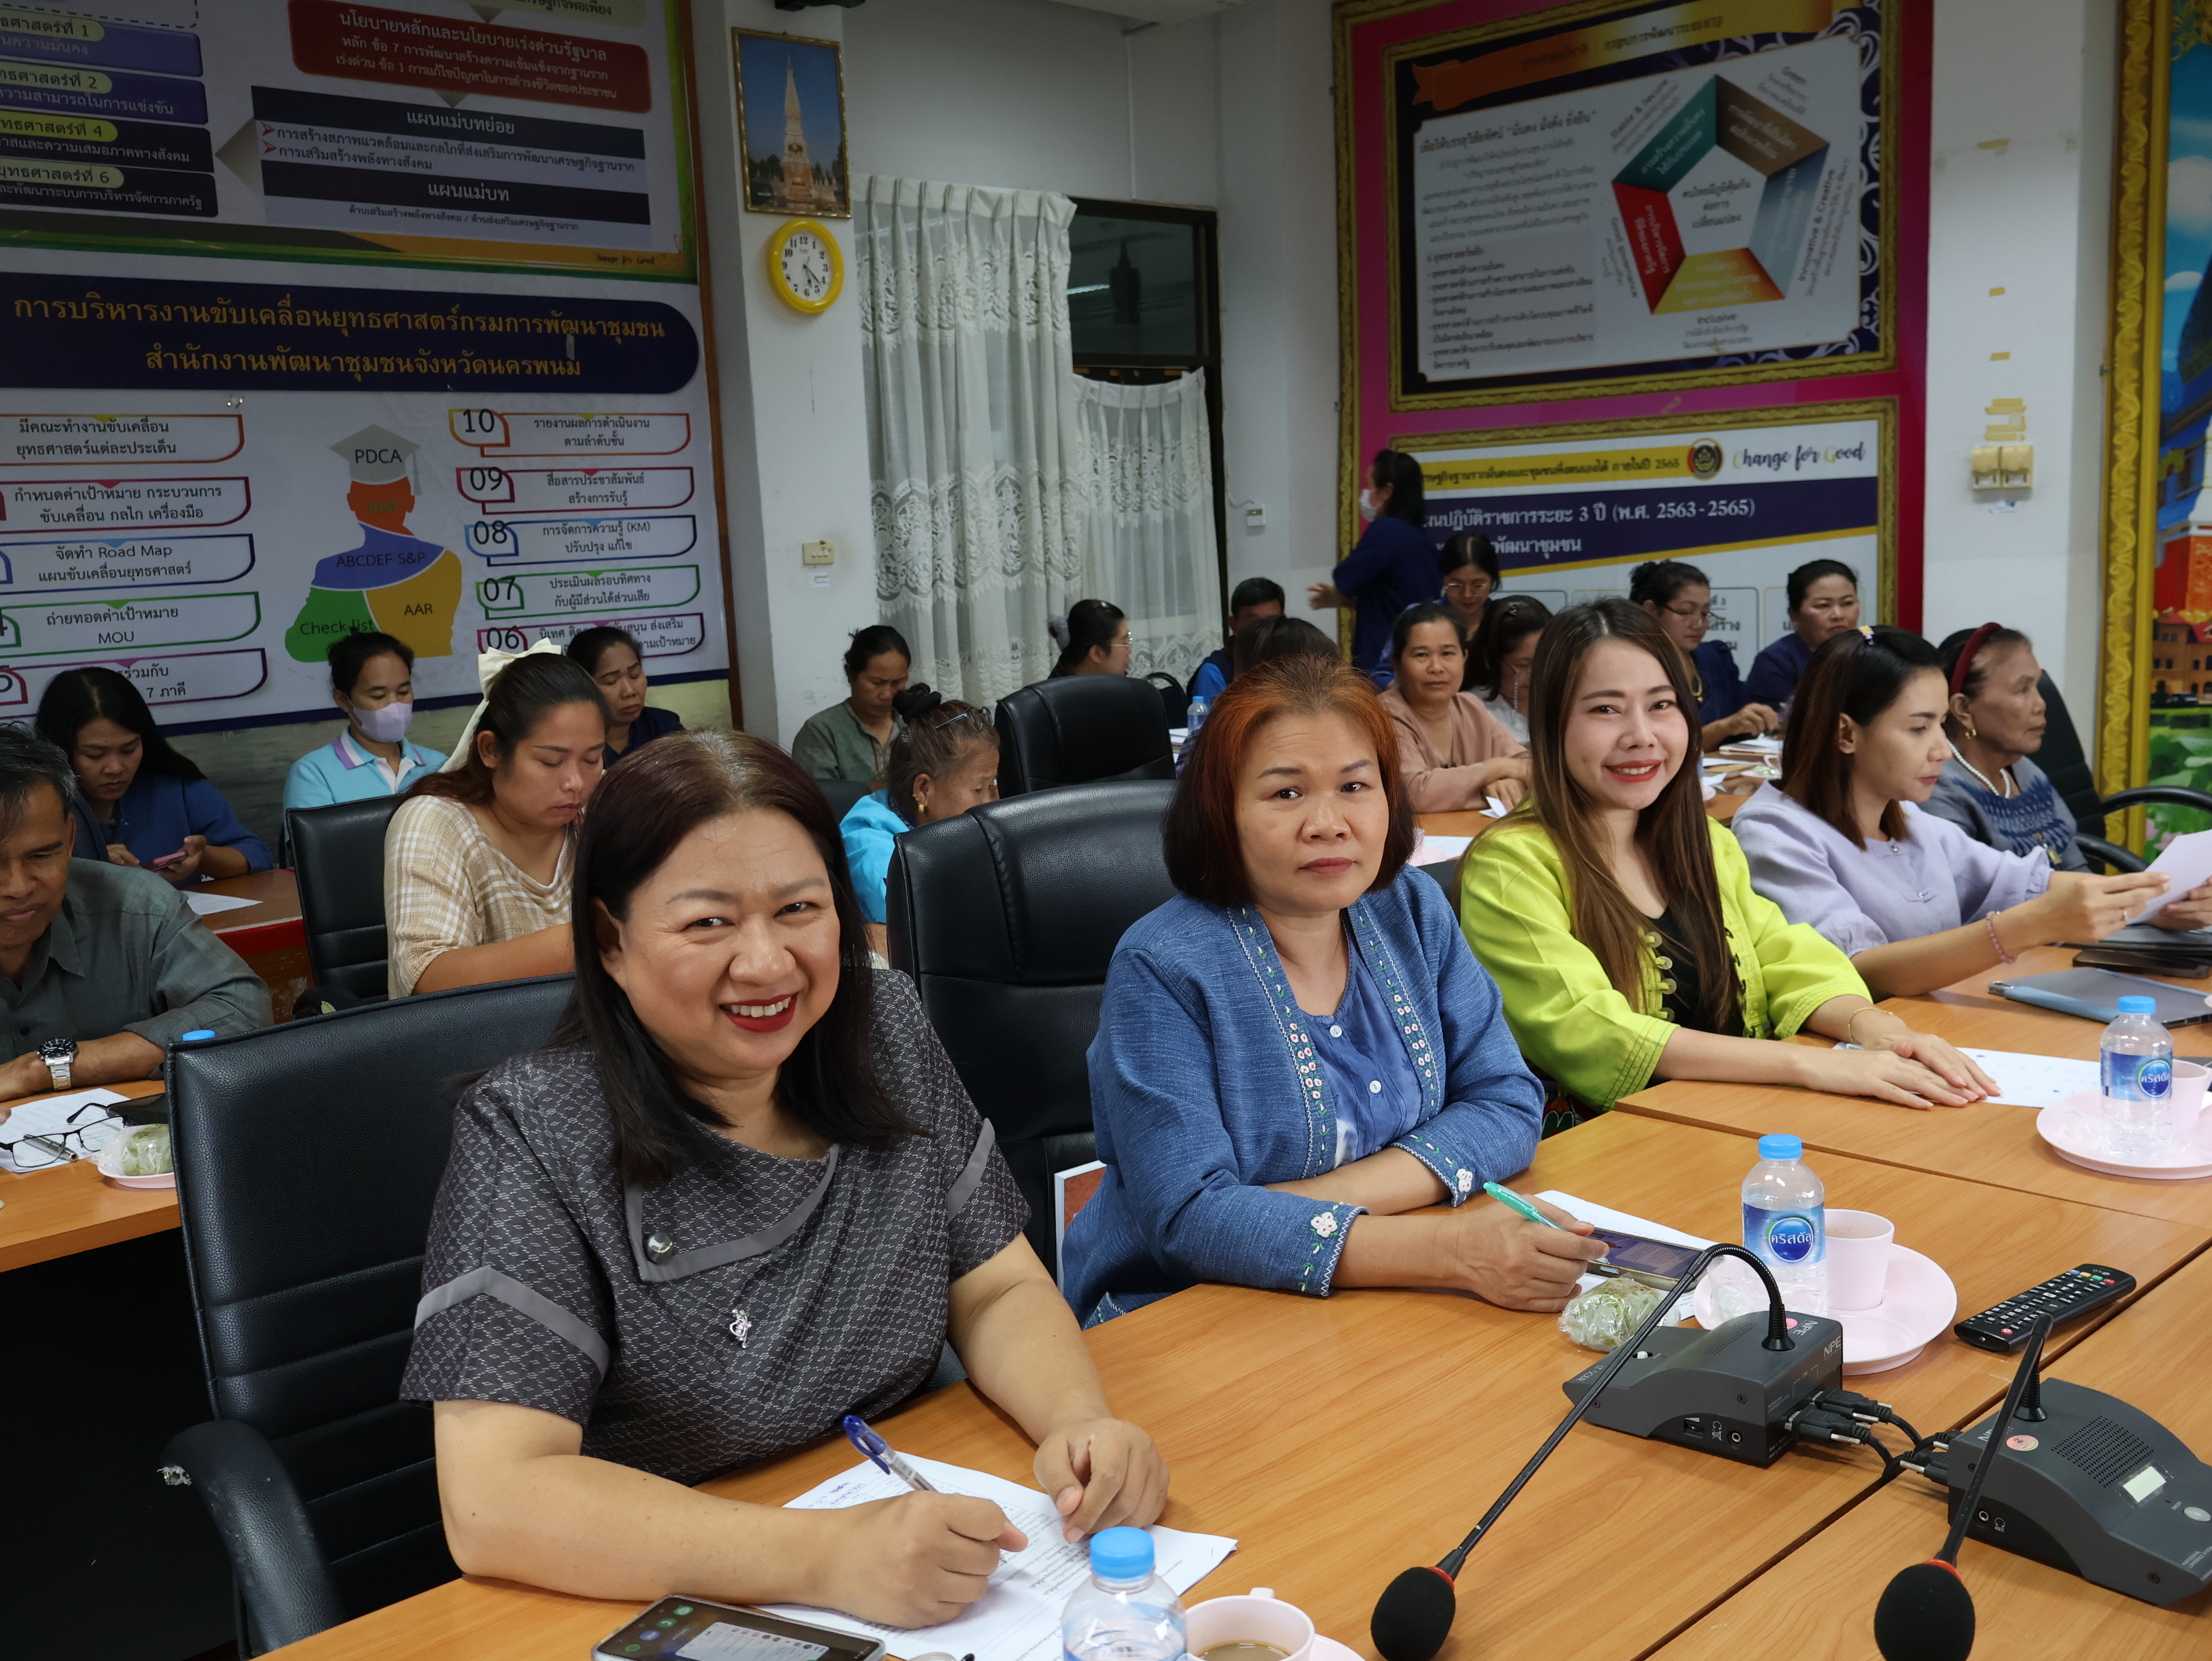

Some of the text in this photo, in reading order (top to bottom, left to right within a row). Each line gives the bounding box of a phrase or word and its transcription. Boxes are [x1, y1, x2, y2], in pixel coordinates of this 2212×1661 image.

[81, 24, 89, 37] 1
[392, 43, 399, 53] 7
[399, 63, 404, 72] 1
[88, 76, 97, 89] 2
[406, 111, 515, 134] แผนแม่บทย่อย
[93, 125, 102, 137] 4
[100, 171, 109, 184] 6
[428, 183, 509, 201] แผนแม่บท
[790, 237, 797, 248] 11
[800, 235, 808, 245] 12
[812, 241, 816, 249] 1
[785, 248, 793, 257] 10
[13, 291, 665, 345] การบริหารงานขับเคลื่อนยุทธศาสตร์กรมการพัฒนาชุมชน
[145, 341, 580, 382] สำนักงานพัฒนาชุมชนจังหวัดนครพนม
[19, 416, 169, 434] มีคณะทำงานขับเคลื่อน
[462, 409, 495, 433] 10
[16, 439, 176, 460] ยุทธศาสตร์แต่ละประเด็น
[355, 449, 402, 463] PDCA
[1795, 445, 1817, 471] for
[470, 467, 503, 491] 09
[547, 472, 645, 487] สื่อสารประชาสัมพันธ์
[14, 486, 222, 502] กำหนดค่าเป้าหมาย กระบวนการ
[568, 491, 629, 506] สร้างการรับรู้
[39, 503, 203, 523] ขับเคลื่อน กลไก เครื่องมือ
[1422, 508, 1573, 531] ผนปฏิบัติราชการระยะ
[1578, 506, 1589, 522] 3
[1592, 502, 1606, 521] ปี
[474, 520, 508, 545] 08
[543, 522, 651, 537] การจัดการความรู้ (KM)
[55, 545, 172, 561] จัดทำ Road Map
[565, 539, 632, 555] ปรับปรุง แก้ไข
[336, 552, 425, 568] ABCDEF S&P
[39, 561, 191, 583] แผนขับเคลื่อนยุทธศาสตร์
[484, 576, 516, 602] 07
[46, 607, 179, 625] ถ่ายทอดค่าเป้าหมาย
[404, 604, 433, 616] AAR
[98, 632, 134, 644] MOU
[487, 625, 519, 649] 06
[146, 688, 154, 698] 7
[1771, 1231, 1812, 1245] คริสตัล
[1793, 1320, 1818, 1336] NPE
[1824, 1335, 1841, 1358] NPE
